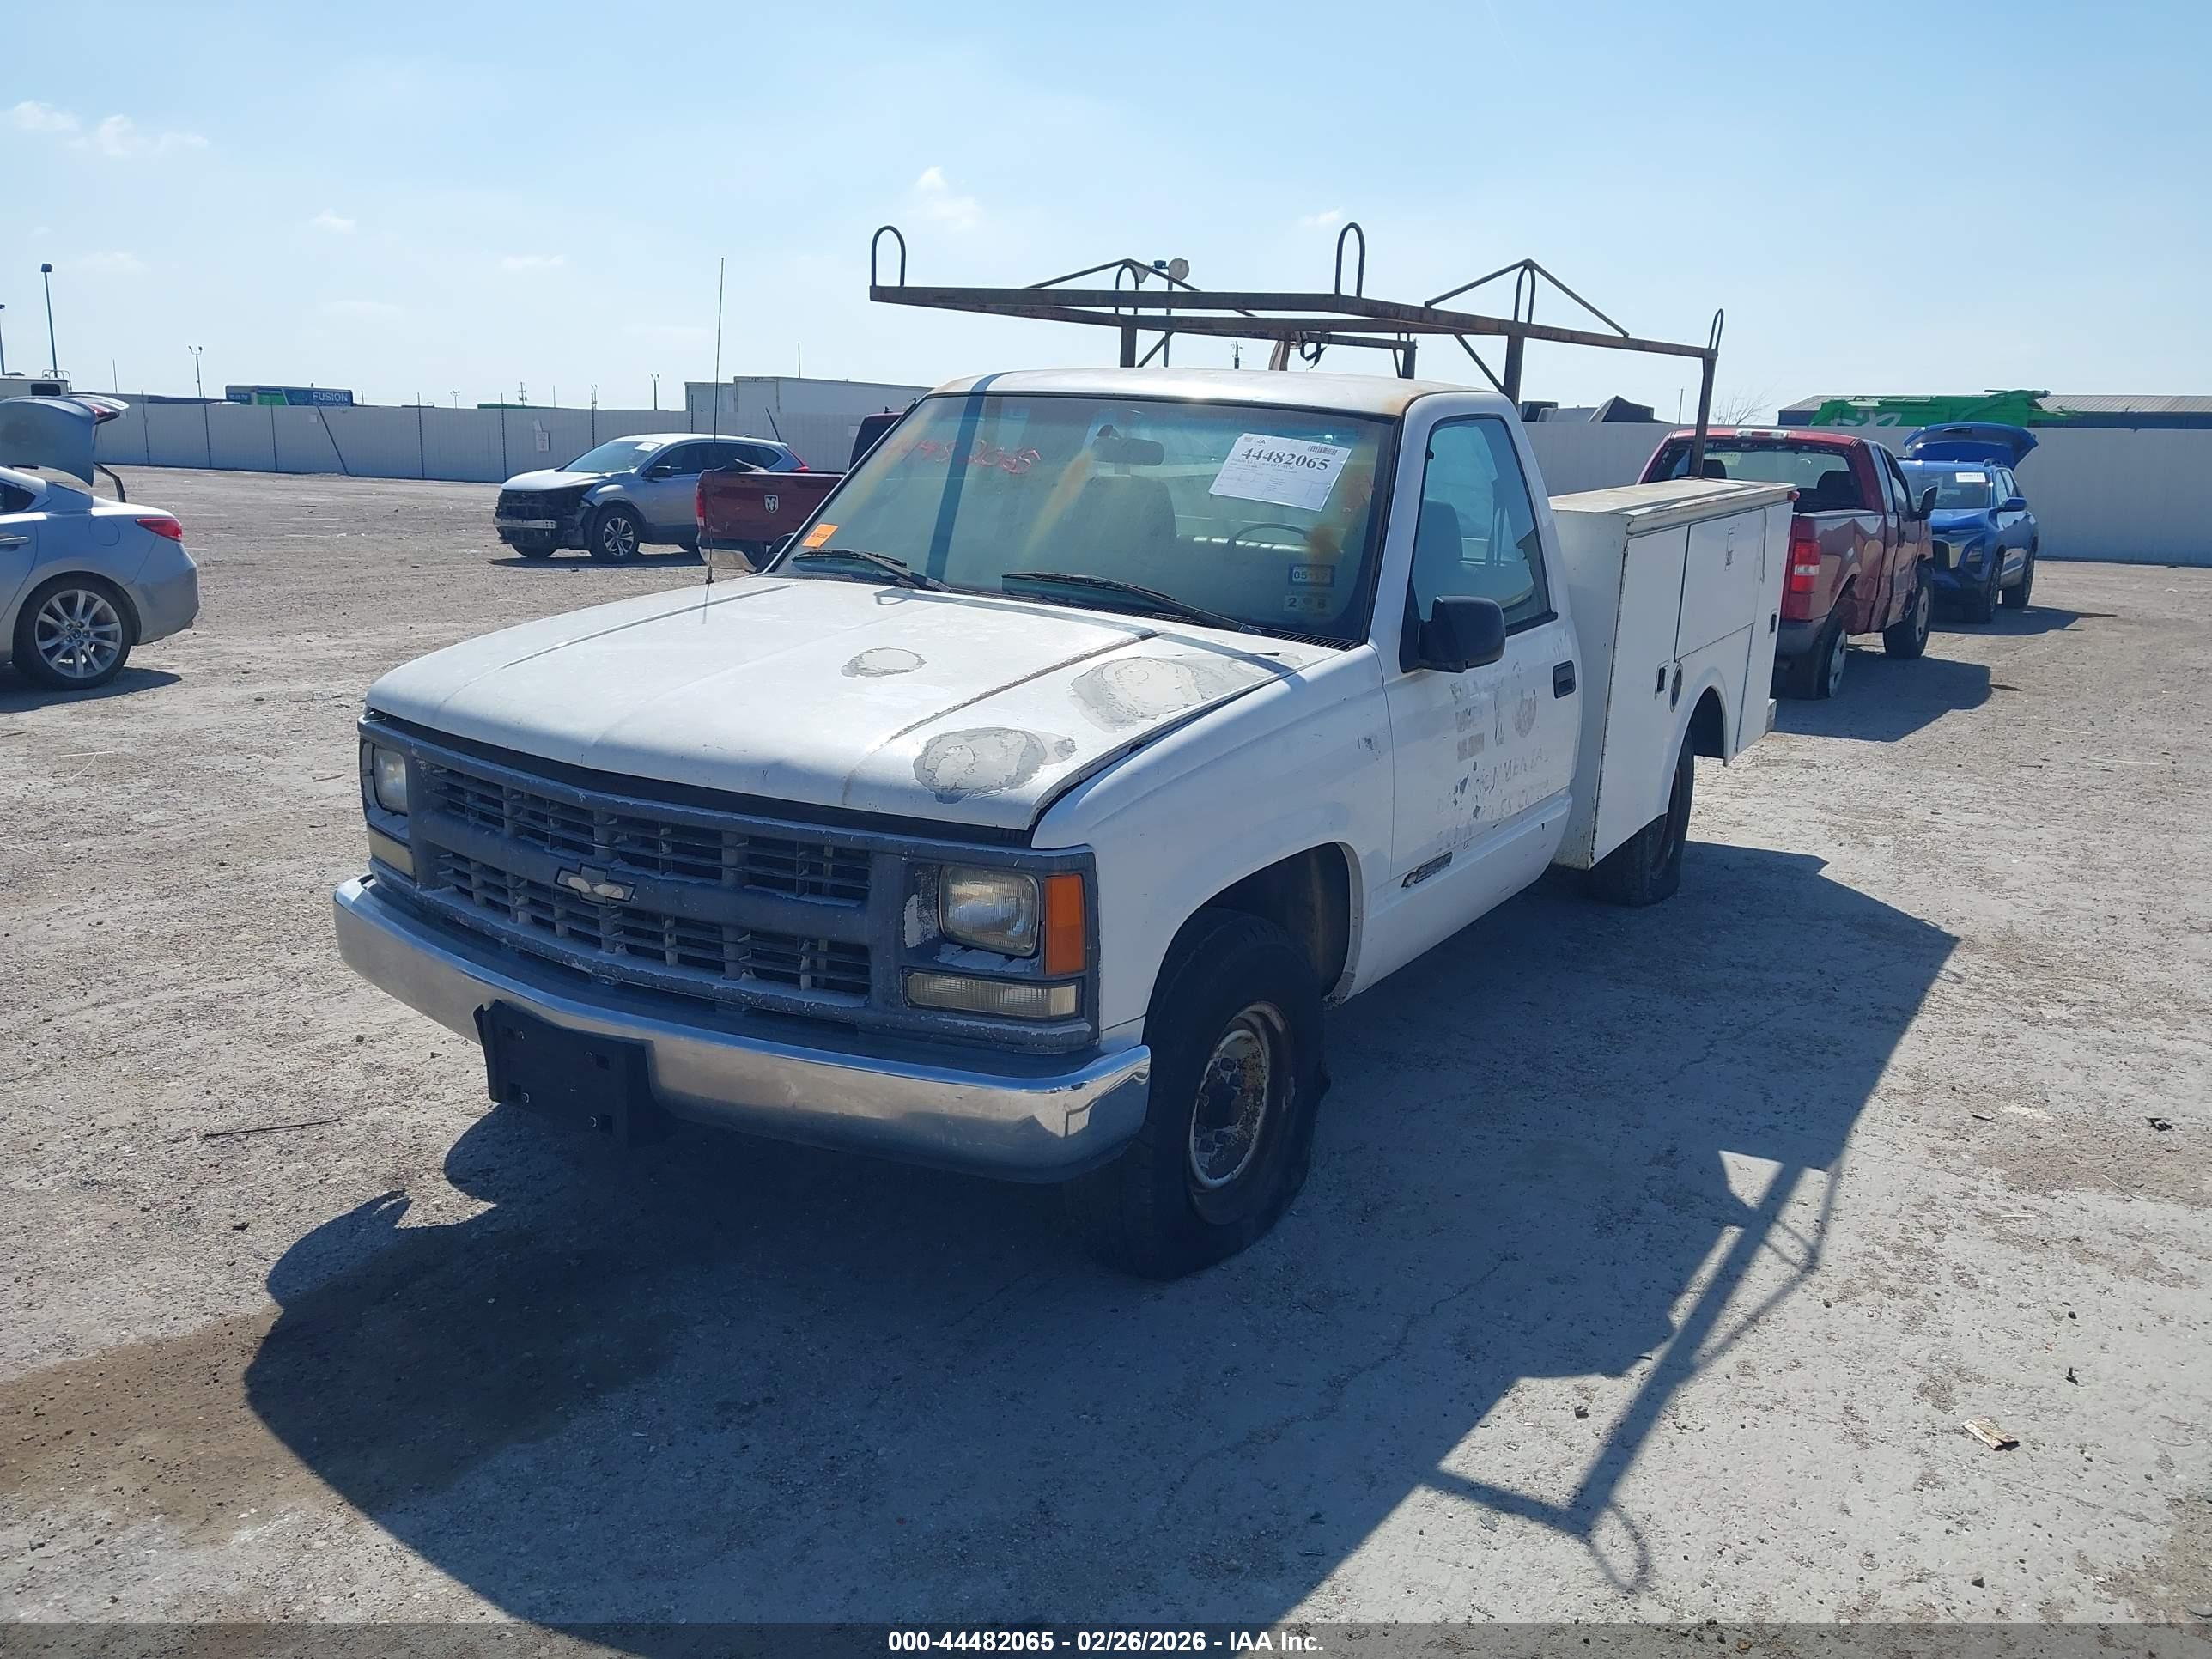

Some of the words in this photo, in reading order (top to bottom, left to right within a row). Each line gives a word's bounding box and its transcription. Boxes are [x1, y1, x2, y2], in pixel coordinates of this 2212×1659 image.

[312, 392, 349, 402] FUSION
[1241, 447, 1332, 471] 44482065
[1294, 570, 1307, 580] 05
[1288, 597, 1297, 608] 2
